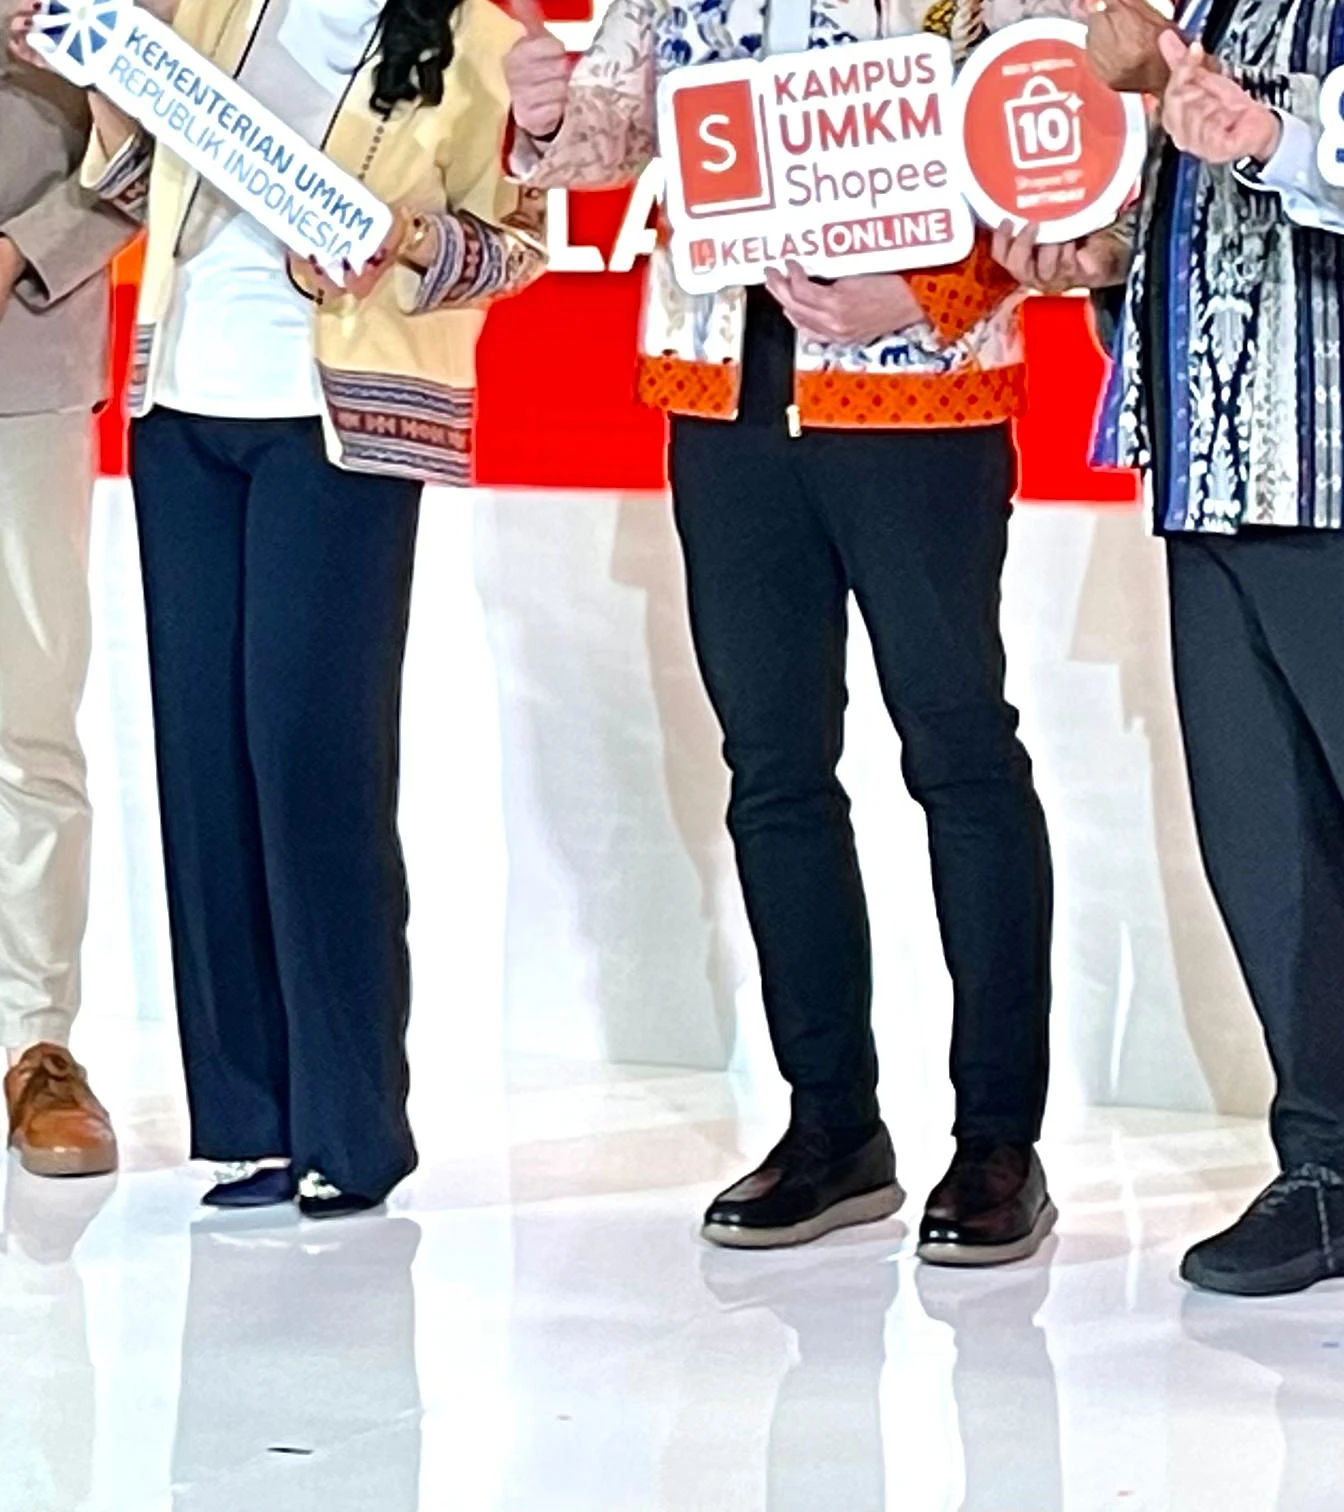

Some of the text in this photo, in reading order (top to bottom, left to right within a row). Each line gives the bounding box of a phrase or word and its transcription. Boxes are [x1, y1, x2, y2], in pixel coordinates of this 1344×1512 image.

[773, 53, 936, 105] KAMPUS
[124, 26, 376, 241] KEMENTERIAN UMKM
[698, 113, 737, 173] S
[778, 93, 943, 155] UMKM
[1018, 107, 1070, 155] 10
[107, 54, 353, 258] REPUBLIK INDONESIA
[784, 158, 949, 209] Shopee
[721, 213, 948, 266] KELAS ONLINE
